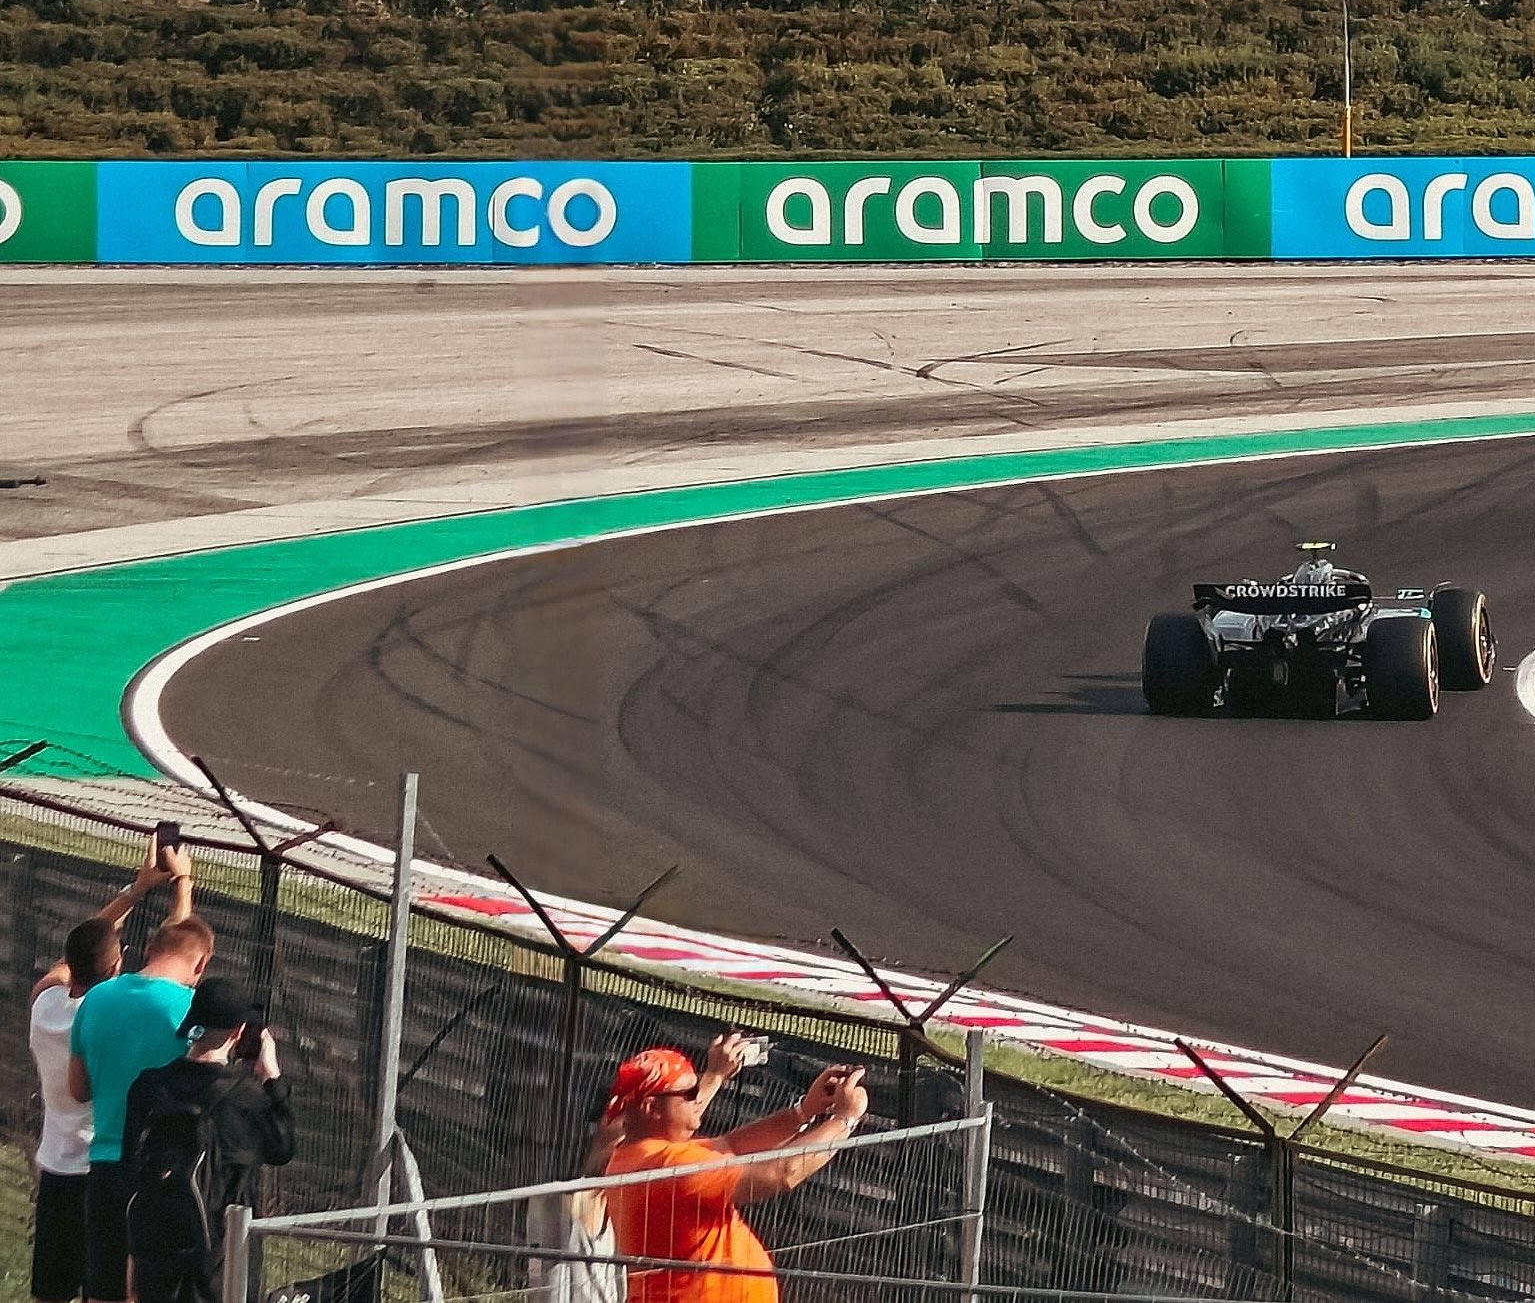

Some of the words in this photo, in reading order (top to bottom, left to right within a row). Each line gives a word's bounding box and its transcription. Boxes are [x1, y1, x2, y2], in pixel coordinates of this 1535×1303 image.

[176, 178, 617, 247] aramco
[767, 176, 1199, 244] aramco
[1225, 584, 1347, 599] CROWDSTRIKE
